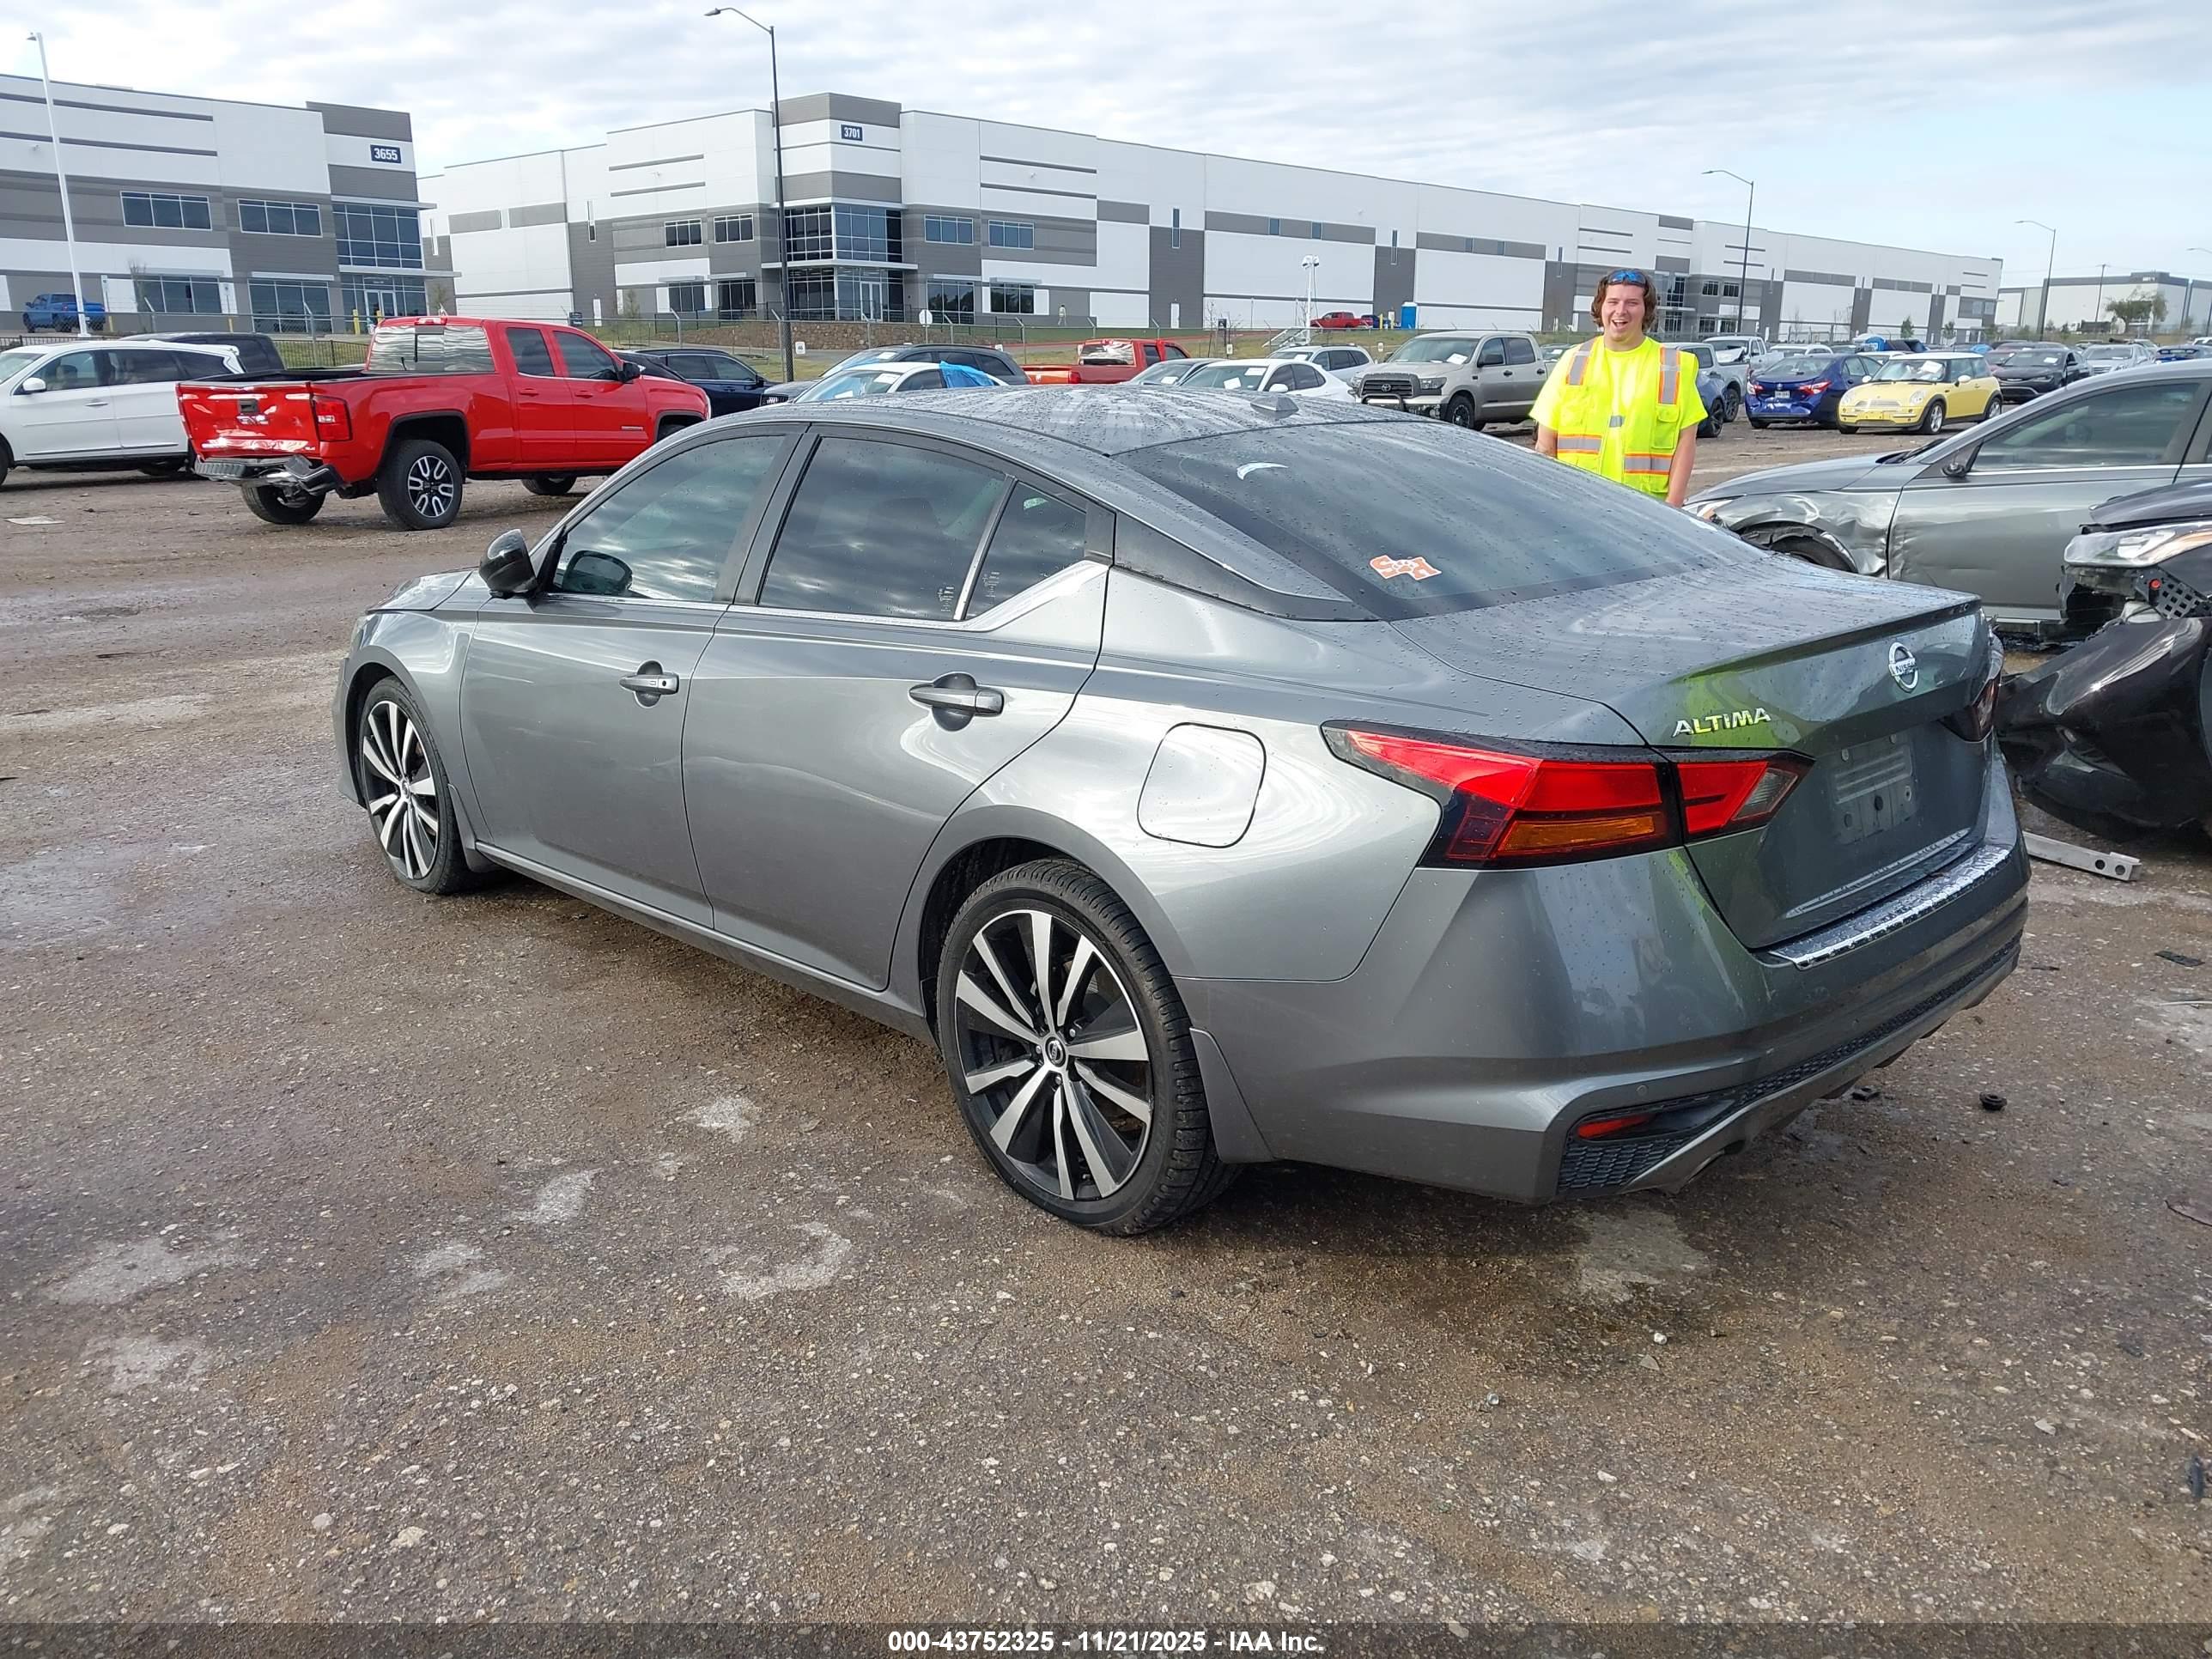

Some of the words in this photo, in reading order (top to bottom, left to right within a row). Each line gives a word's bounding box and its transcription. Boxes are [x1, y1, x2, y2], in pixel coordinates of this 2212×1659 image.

[844, 126, 860, 138] 3701
[374, 148, 398, 161] 3655
[1672, 707, 1771, 738] ALTIMA
